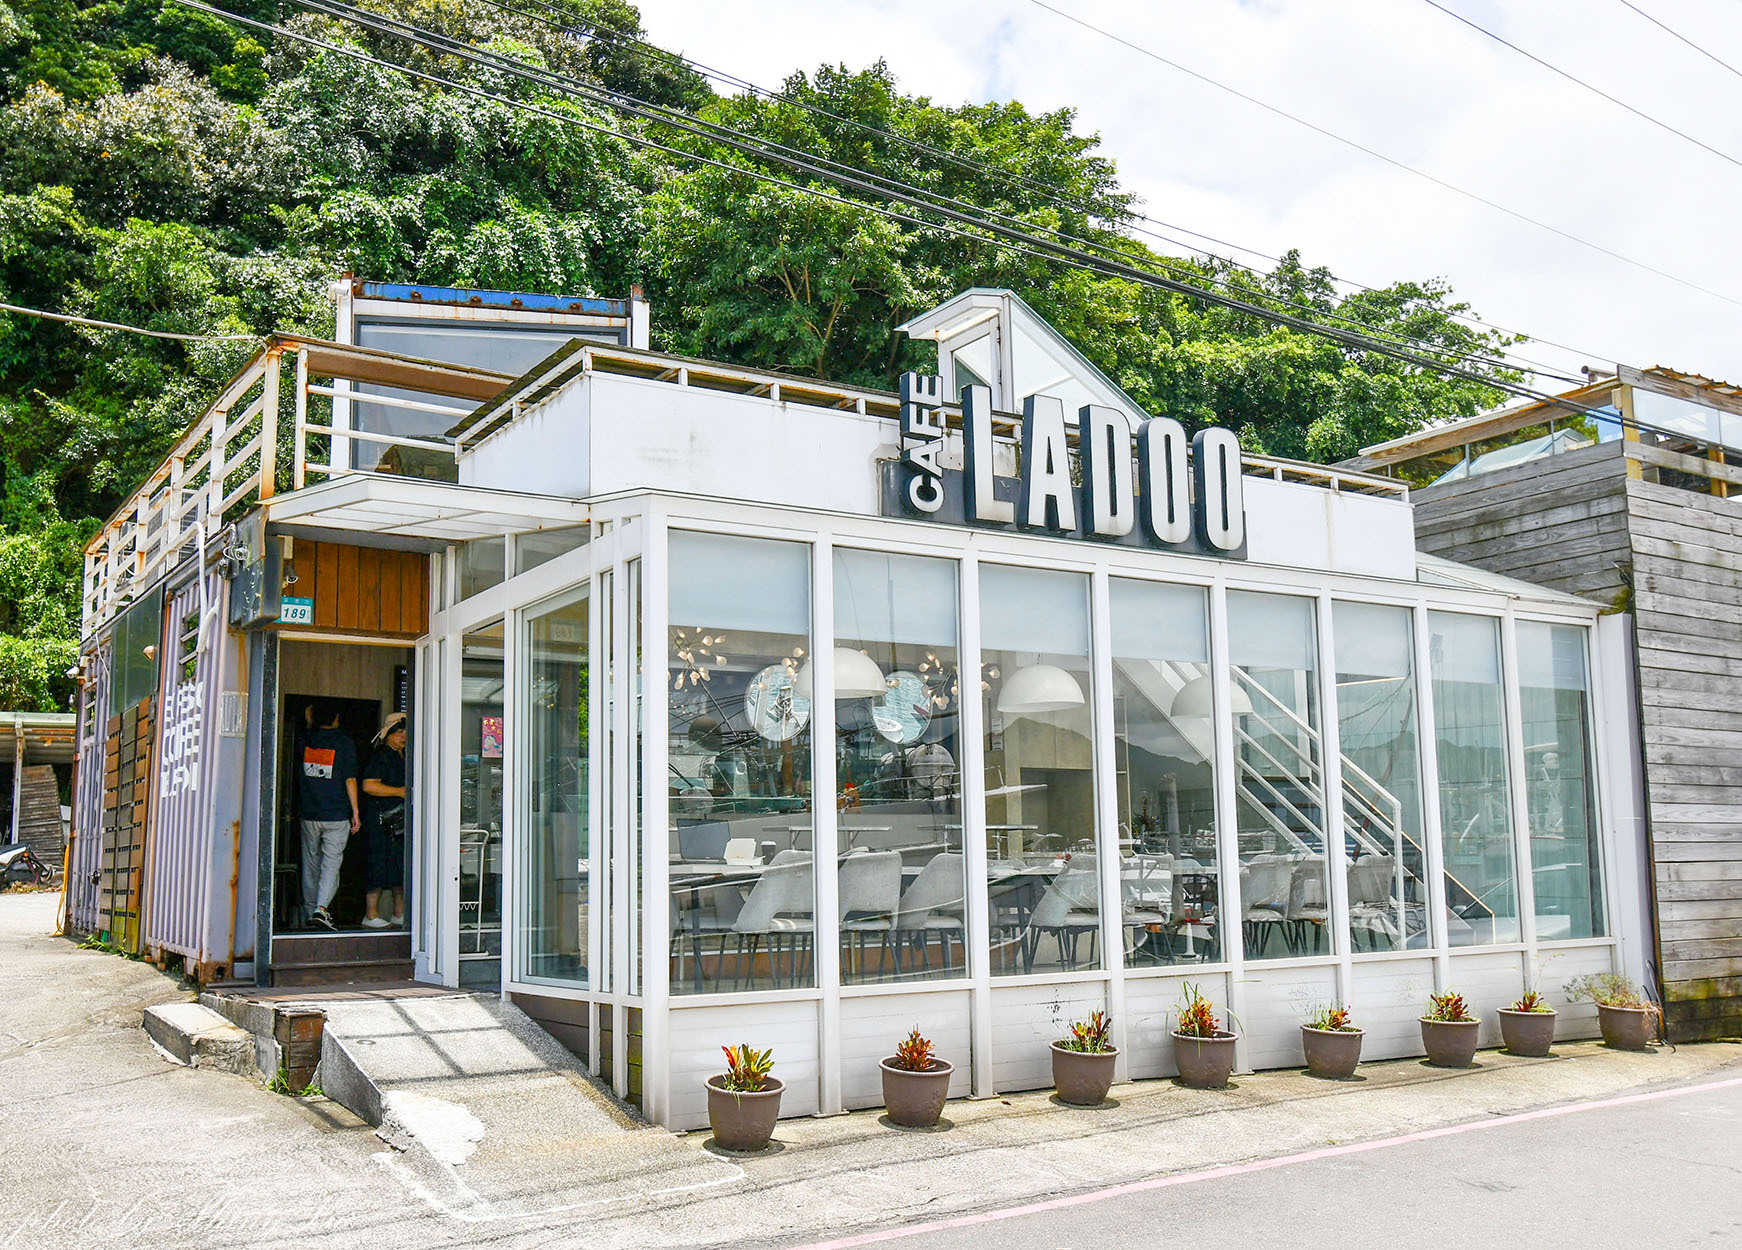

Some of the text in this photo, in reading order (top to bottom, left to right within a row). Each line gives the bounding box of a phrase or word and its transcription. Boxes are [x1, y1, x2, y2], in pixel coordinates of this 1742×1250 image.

[902, 371, 945, 514] CAFE
[964, 383, 1245, 552] LADOO
[284, 607, 306, 620] 189
